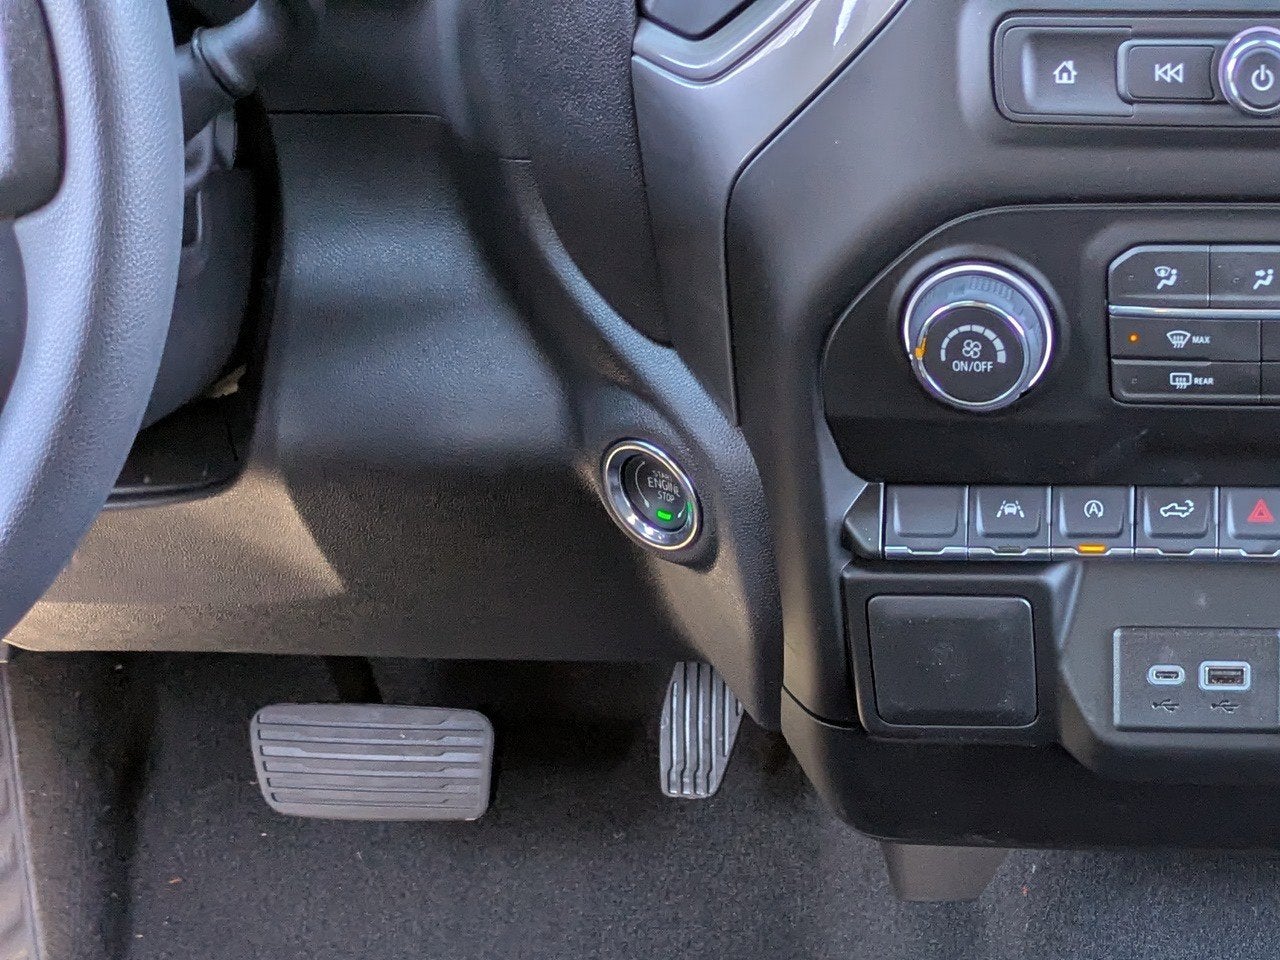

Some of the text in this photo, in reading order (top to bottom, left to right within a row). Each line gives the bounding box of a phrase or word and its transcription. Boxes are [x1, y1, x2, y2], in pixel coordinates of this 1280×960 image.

[1192, 336, 1210, 344] MAX
[952, 360, 993, 372] ON/OFF
[1193, 377, 1214, 385] REAR
[647, 476, 680, 498] ENGINE
[658, 490, 675, 502] STOP
